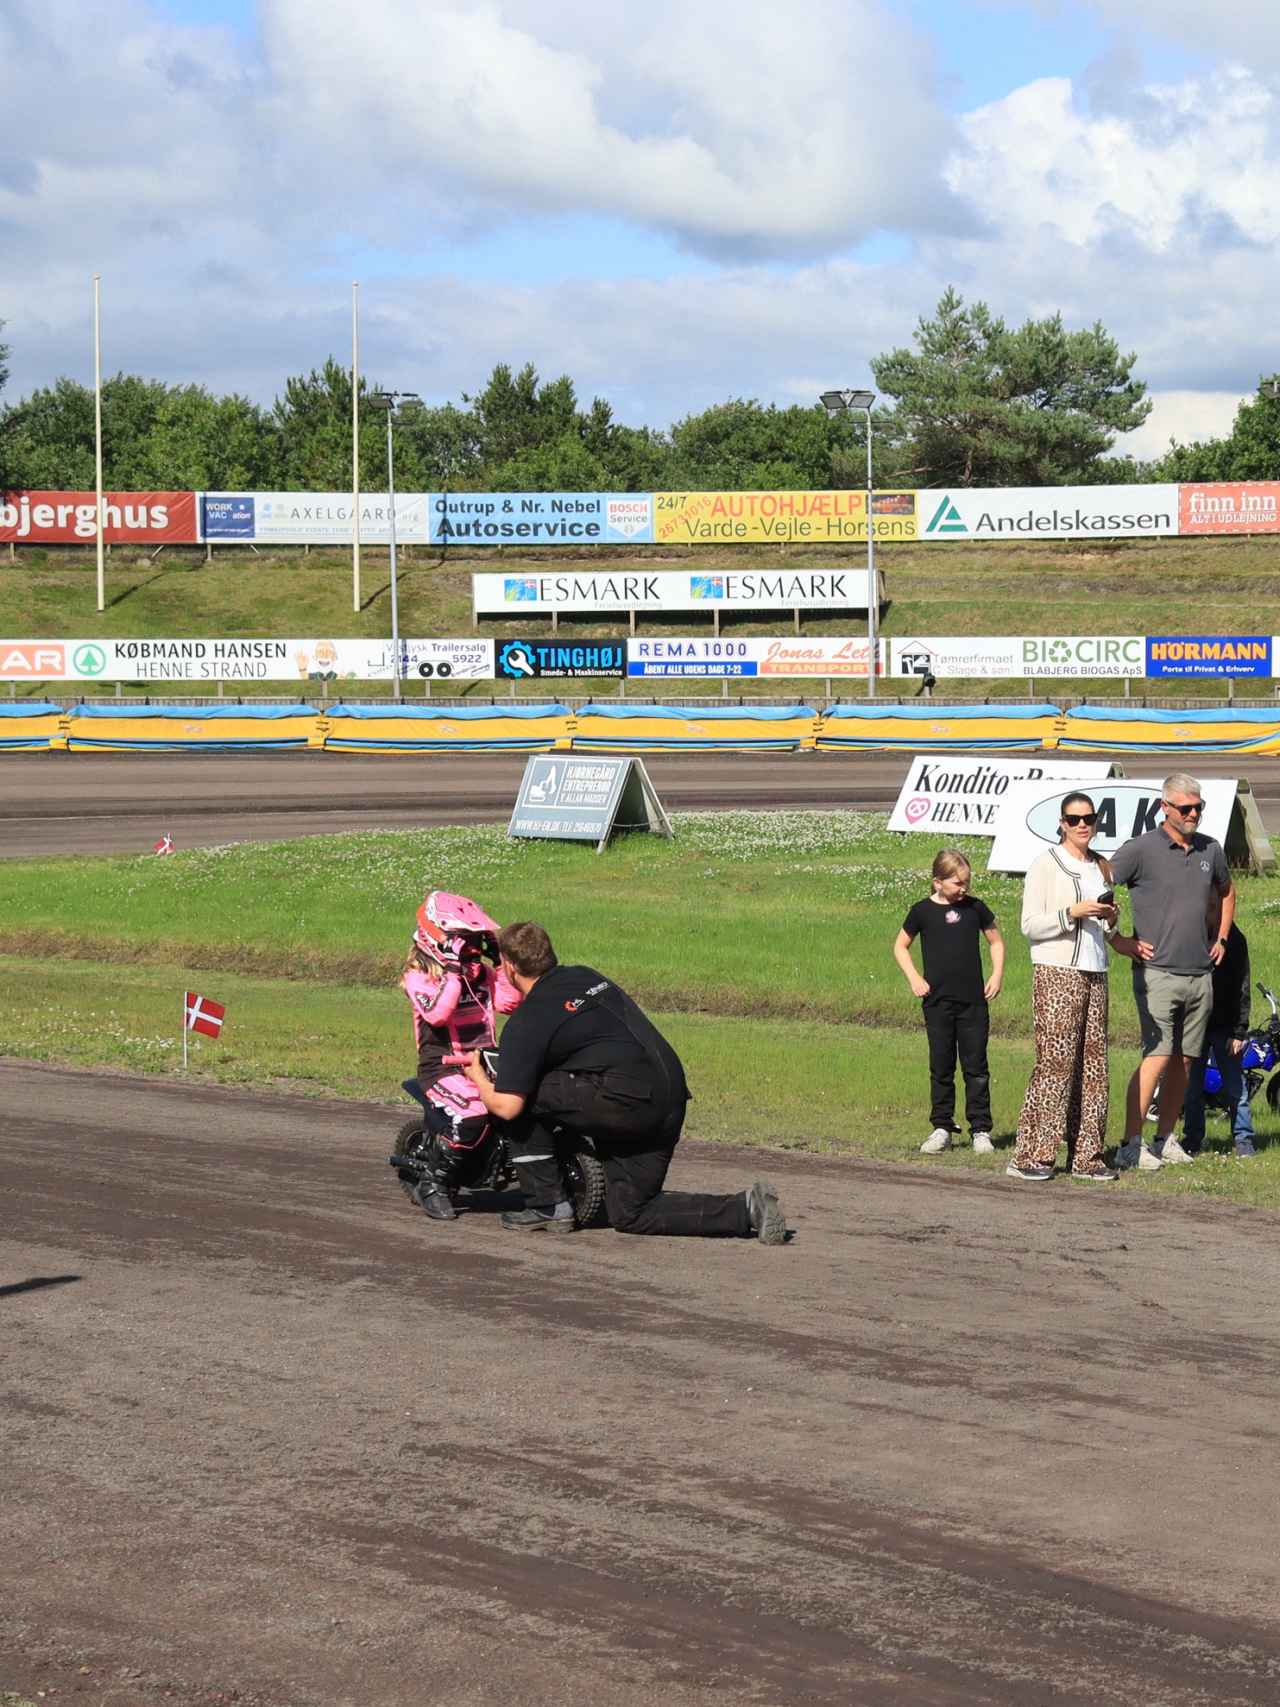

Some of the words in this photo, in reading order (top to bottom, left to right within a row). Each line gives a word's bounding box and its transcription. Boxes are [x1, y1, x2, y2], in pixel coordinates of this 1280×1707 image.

[206, 503, 233, 511] WORK
[435, 500, 495, 516] Outrup
[502, 500, 513, 513] &
[521, 500, 544, 513] Nr.
[551, 499, 600, 513] Nebel
[609, 503, 648, 512] BOSCH
[657, 496, 687, 509] 24/7
[710, 495, 863, 517] AUTOHJÆLP
[1189, 492, 1235, 512] finn
[1240, 491, 1277, 511] inn
[209, 511, 227, 519] VAC
[610, 514, 647, 523] Service
[976, 509, 1171, 532] Andelskassen
[1219, 512, 1277, 524] UDLEJNING
[436, 517, 600, 537] Autoservice
[685, 520, 747, 537] Varde
[759, 518, 812, 541] Vejle
[540, 577, 661, 601] ESMARK
[727, 575, 848, 599] ESMARK
[115, 643, 206, 658] KØBMAND
[214, 643, 287, 658] HANSEN
[431, 643, 486, 653] Trailersalg
[640, 643, 697, 656] REMA
[704, 643, 747, 656] 1000
[1151, 641, 1267, 660] HÖRMANN
[452, 655, 482, 663] 5922
[536, 648, 622, 668] TINGHØJ
[136, 662, 192, 678] HENNE
[200, 662, 267, 678] STRAND
[1080, 666, 1120, 675] BIOGAS
[1122, 666, 1143, 676] ApS
[930, 802, 1000, 825] HENNE
